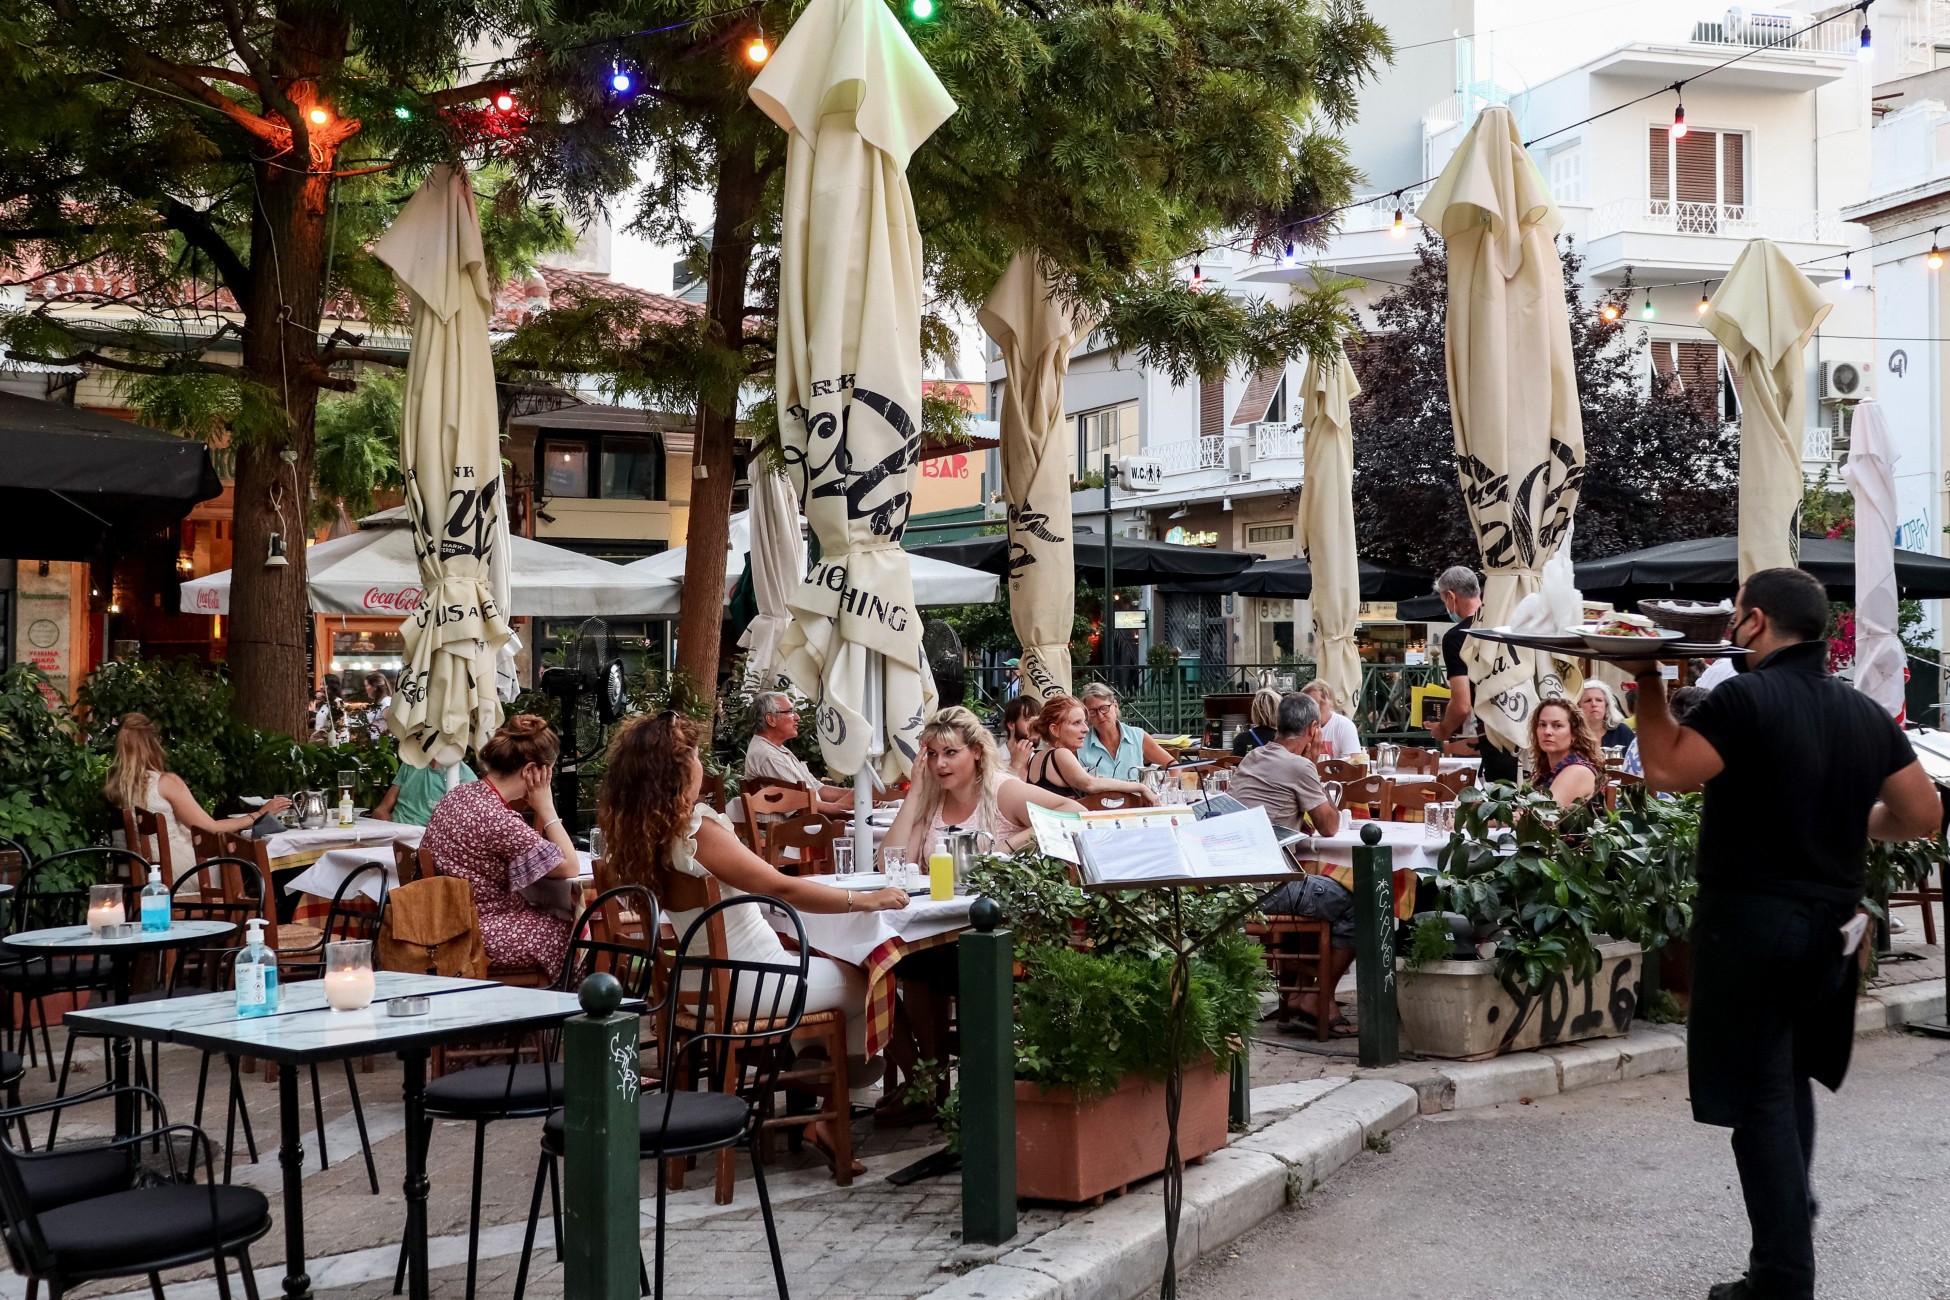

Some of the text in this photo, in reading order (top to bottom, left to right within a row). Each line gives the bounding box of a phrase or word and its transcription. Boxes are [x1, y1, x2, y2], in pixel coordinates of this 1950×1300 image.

[922, 454, 969, 479] BAR
[1131, 466, 1147, 480] W.C.
[363, 586, 423, 611] Coca-Col
